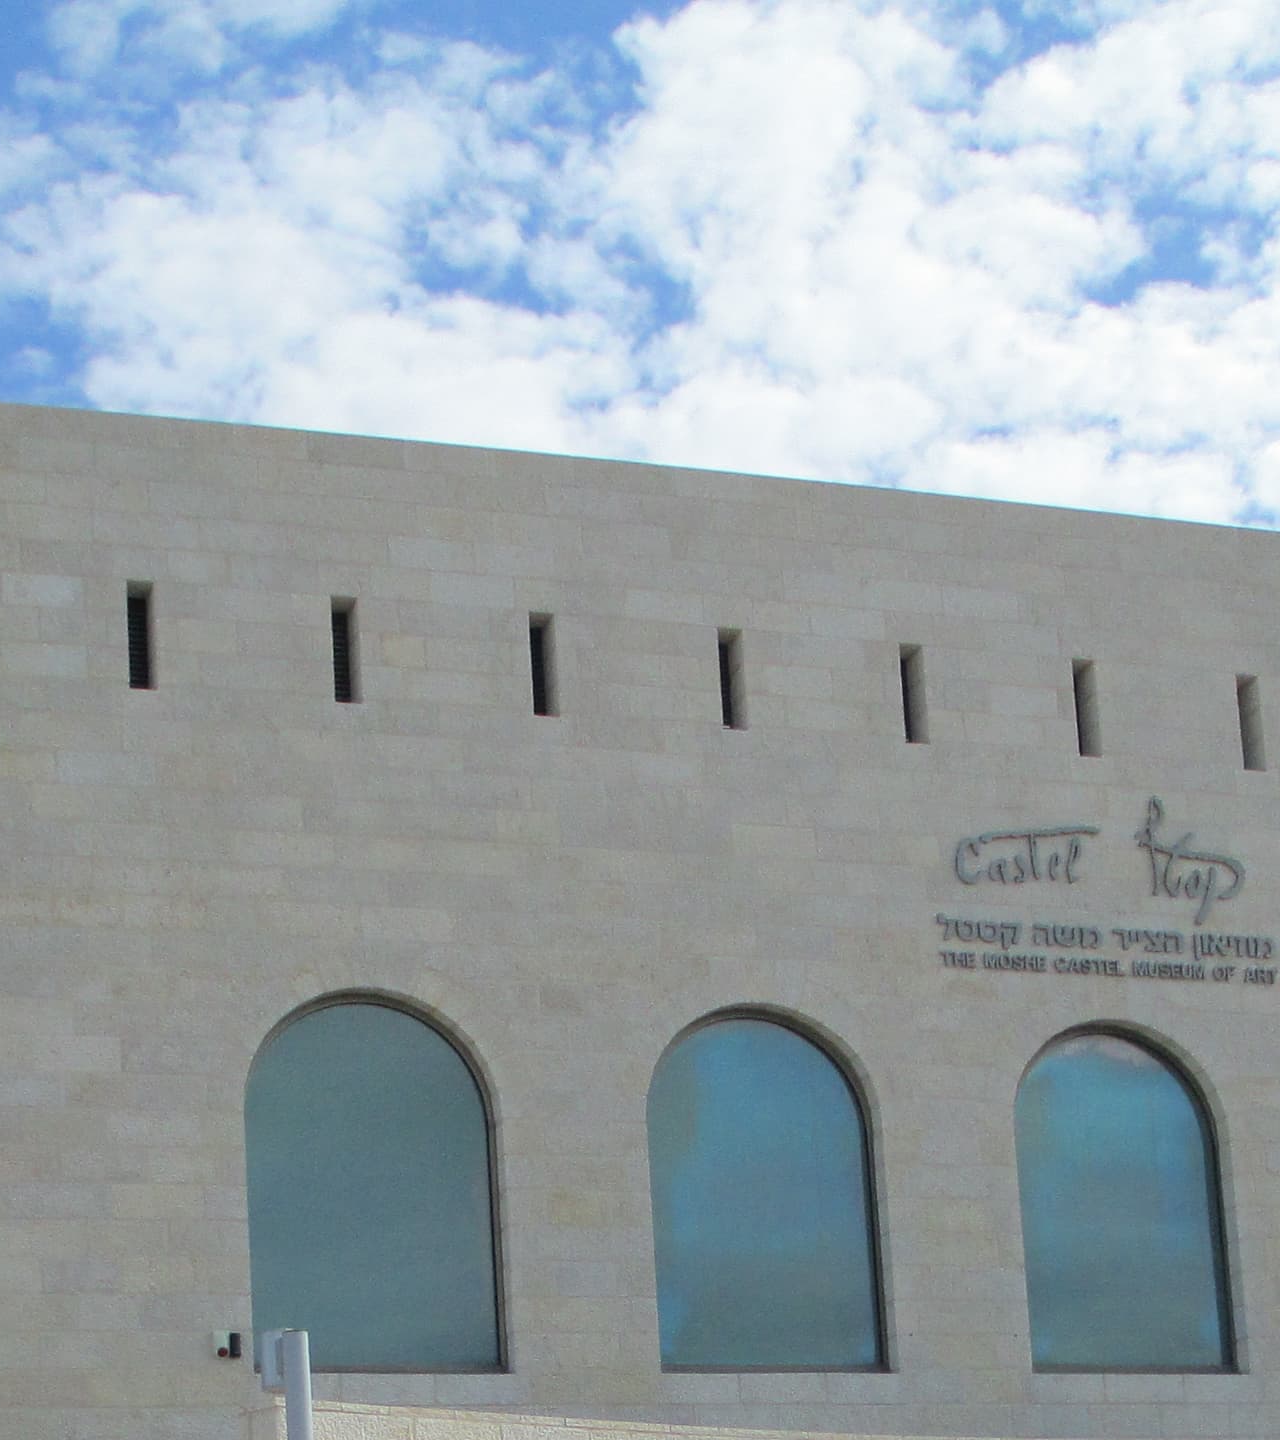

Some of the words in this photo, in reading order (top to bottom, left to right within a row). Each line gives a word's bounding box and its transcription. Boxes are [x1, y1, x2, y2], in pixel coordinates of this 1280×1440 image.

[954, 825, 1100, 886] Castel
[1033, 923, 1101, 950] משה
[1112, 928, 1184, 953] הצייר
[1193, 933, 1275, 960] מוזיאון
[939, 951, 977, 969] THE
[983, 952, 1047, 972] MOSHE
[1054, 957, 1124, 977] CASTEL
[1132, 961, 1205, 980] MUSEUM
[1213, 966, 1236, 982] OF
[1243, 967, 1278, 984] ART
